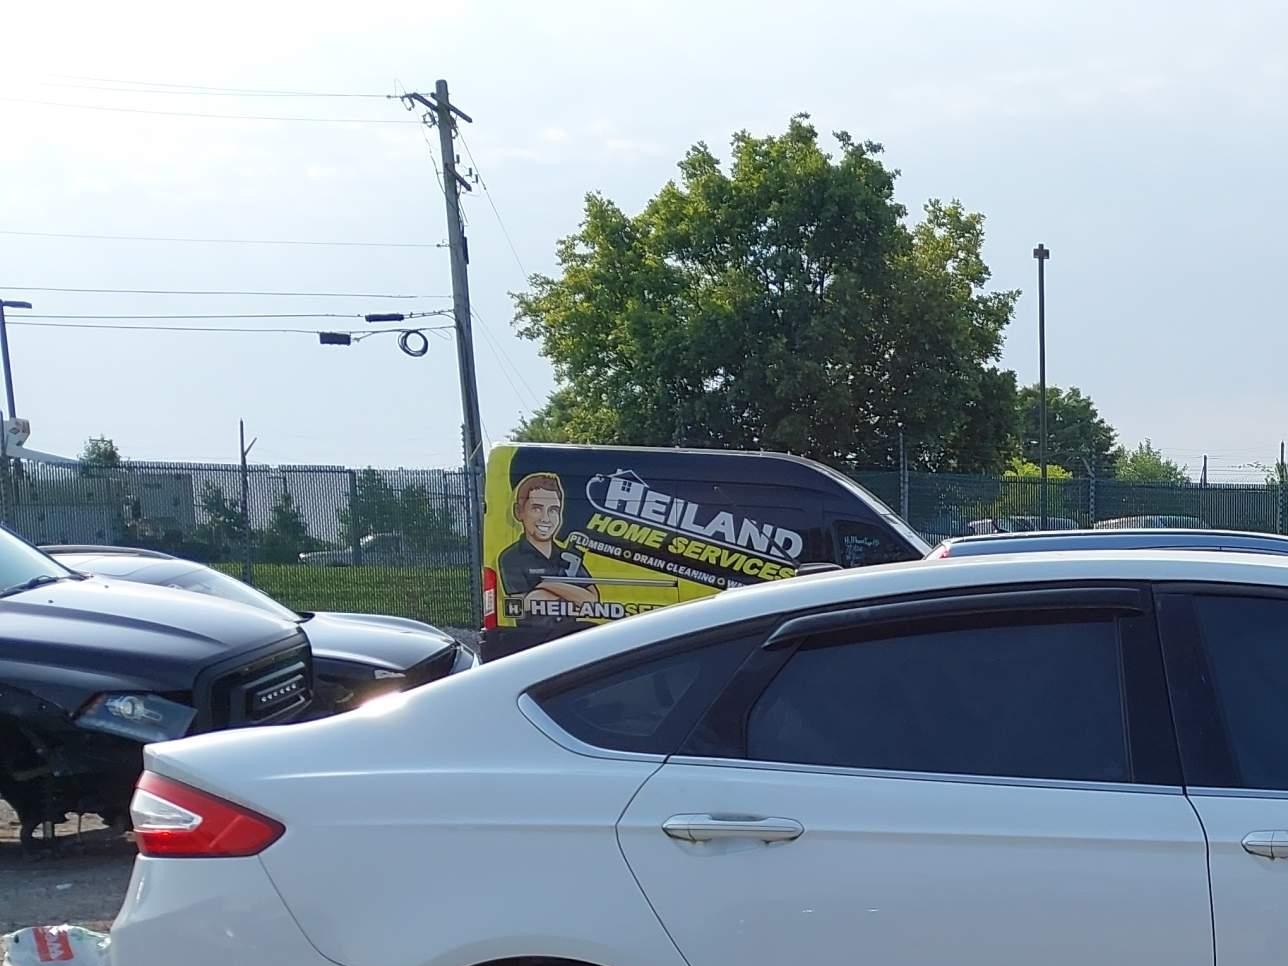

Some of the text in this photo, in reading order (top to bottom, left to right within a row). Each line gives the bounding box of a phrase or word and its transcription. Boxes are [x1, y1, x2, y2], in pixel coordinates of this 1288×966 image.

[586, 513, 797, 581] HOME SERVICES
[604, 476, 803, 560] HEILAND
[569, 535, 622, 557] PLUMBING
[632, 552, 666, 569] DRAIN
[665, 562, 717, 584] CLEANING
[531, 600, 666, 620] HEILANDS
